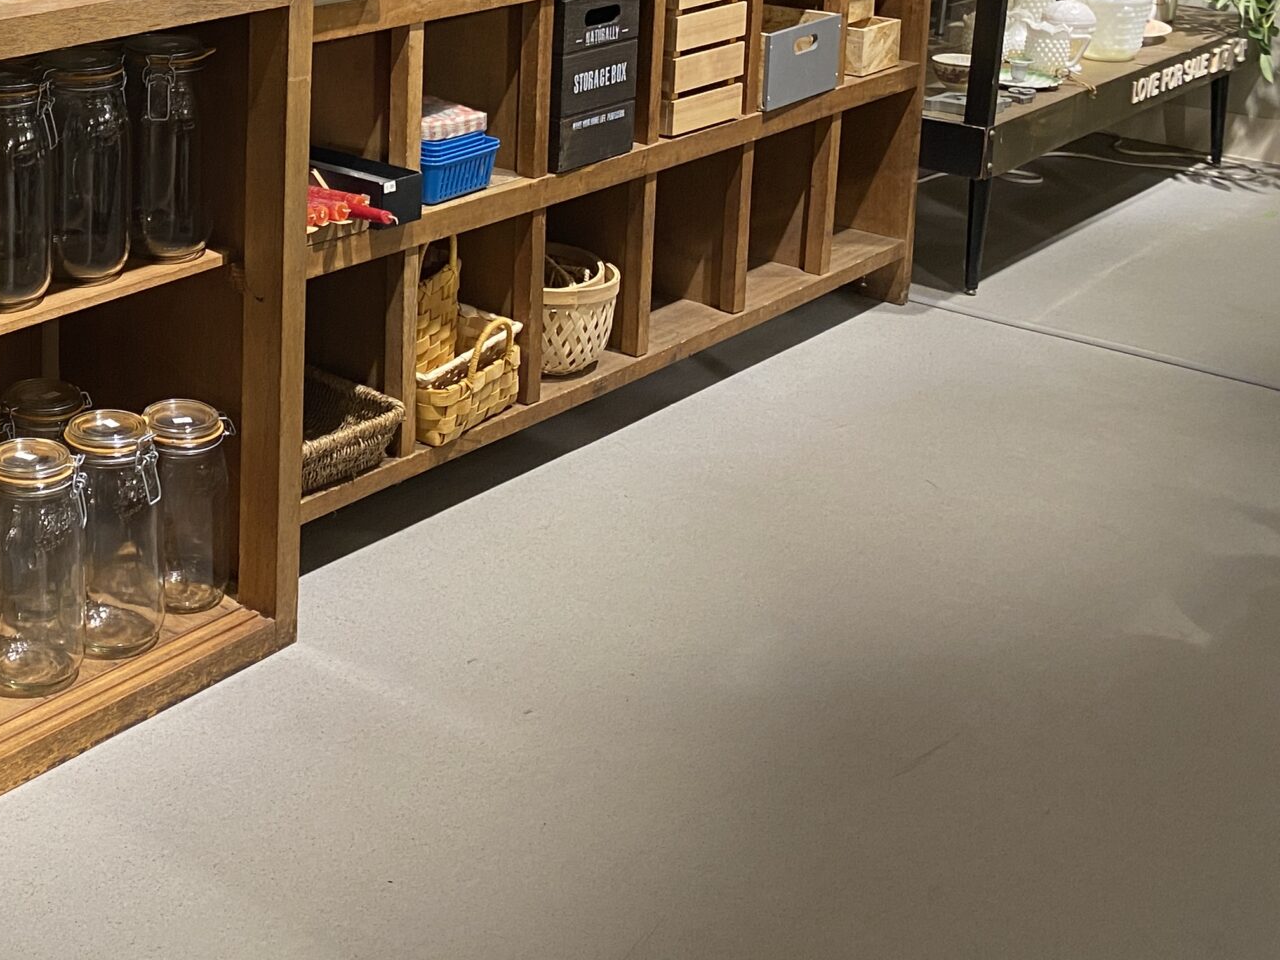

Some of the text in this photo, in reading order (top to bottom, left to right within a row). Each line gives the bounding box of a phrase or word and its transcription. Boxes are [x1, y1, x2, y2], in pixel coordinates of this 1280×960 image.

[585, 25, 620, 46] NATURALLY
[573, 62, 627, 94] STORAGE BOX
[1131, 72, 1161, 104] LOVE
[1160, 64, 1184, 92] FOR
[1183, 53, 1211, 82] SALE
